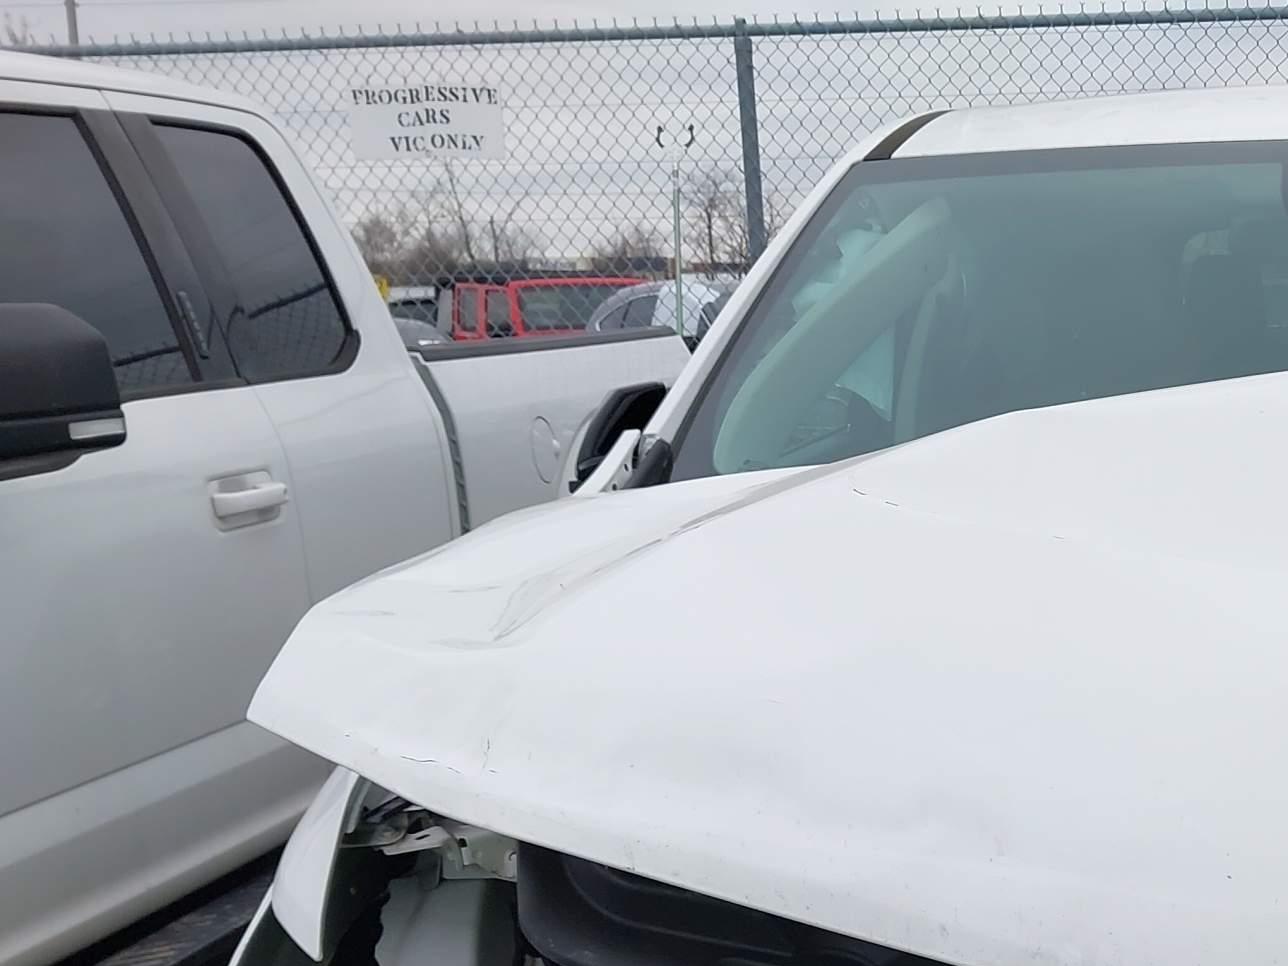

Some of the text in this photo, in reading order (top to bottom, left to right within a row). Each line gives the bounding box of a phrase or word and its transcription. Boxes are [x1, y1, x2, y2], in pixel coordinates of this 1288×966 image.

[351, 85, 498, 105] PROGRESSIVE
[397, 108, 451, 128] CARS
[389, 134, 485, 152] VIC ONLY
